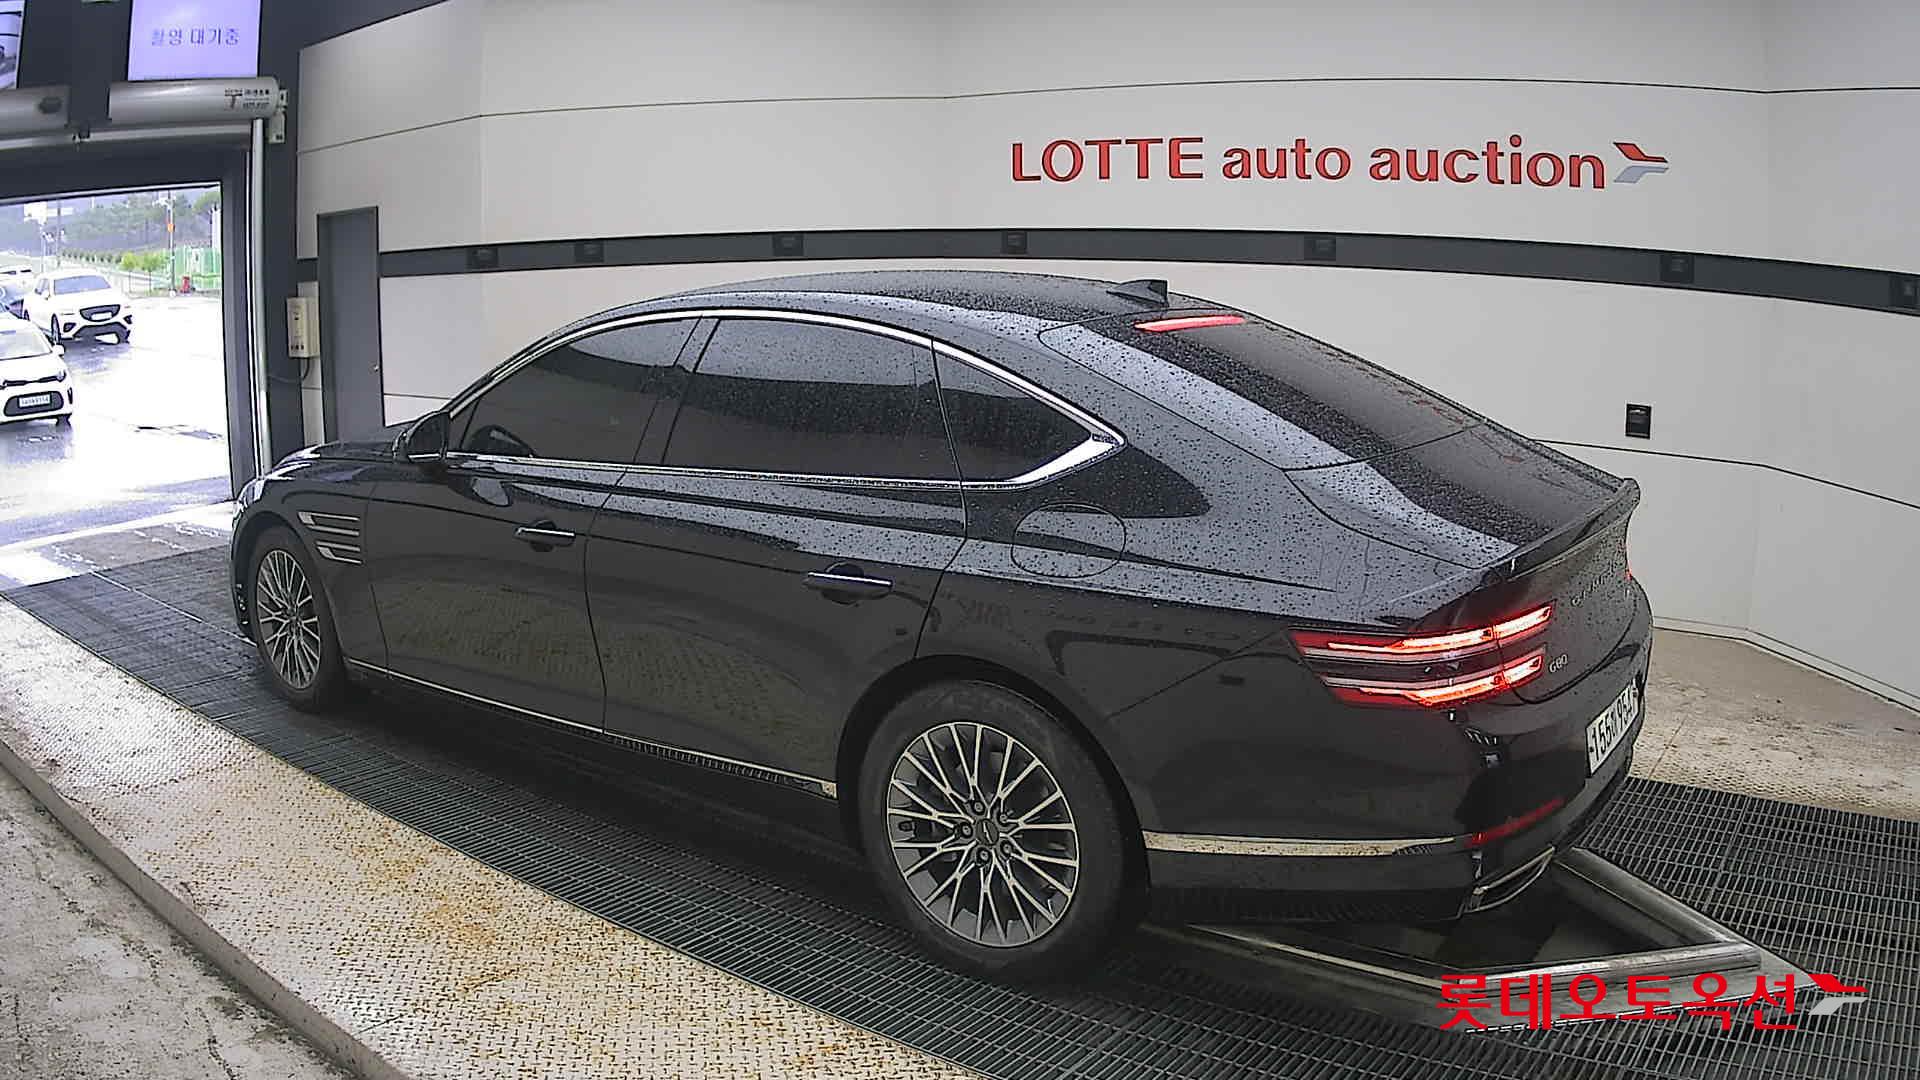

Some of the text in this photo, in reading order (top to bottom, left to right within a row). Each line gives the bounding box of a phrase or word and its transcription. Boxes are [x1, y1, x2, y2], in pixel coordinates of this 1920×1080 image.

[190, 27, 239, 46] 대기중
[1012, 134, 1606, 189] LOTTE auto auction
